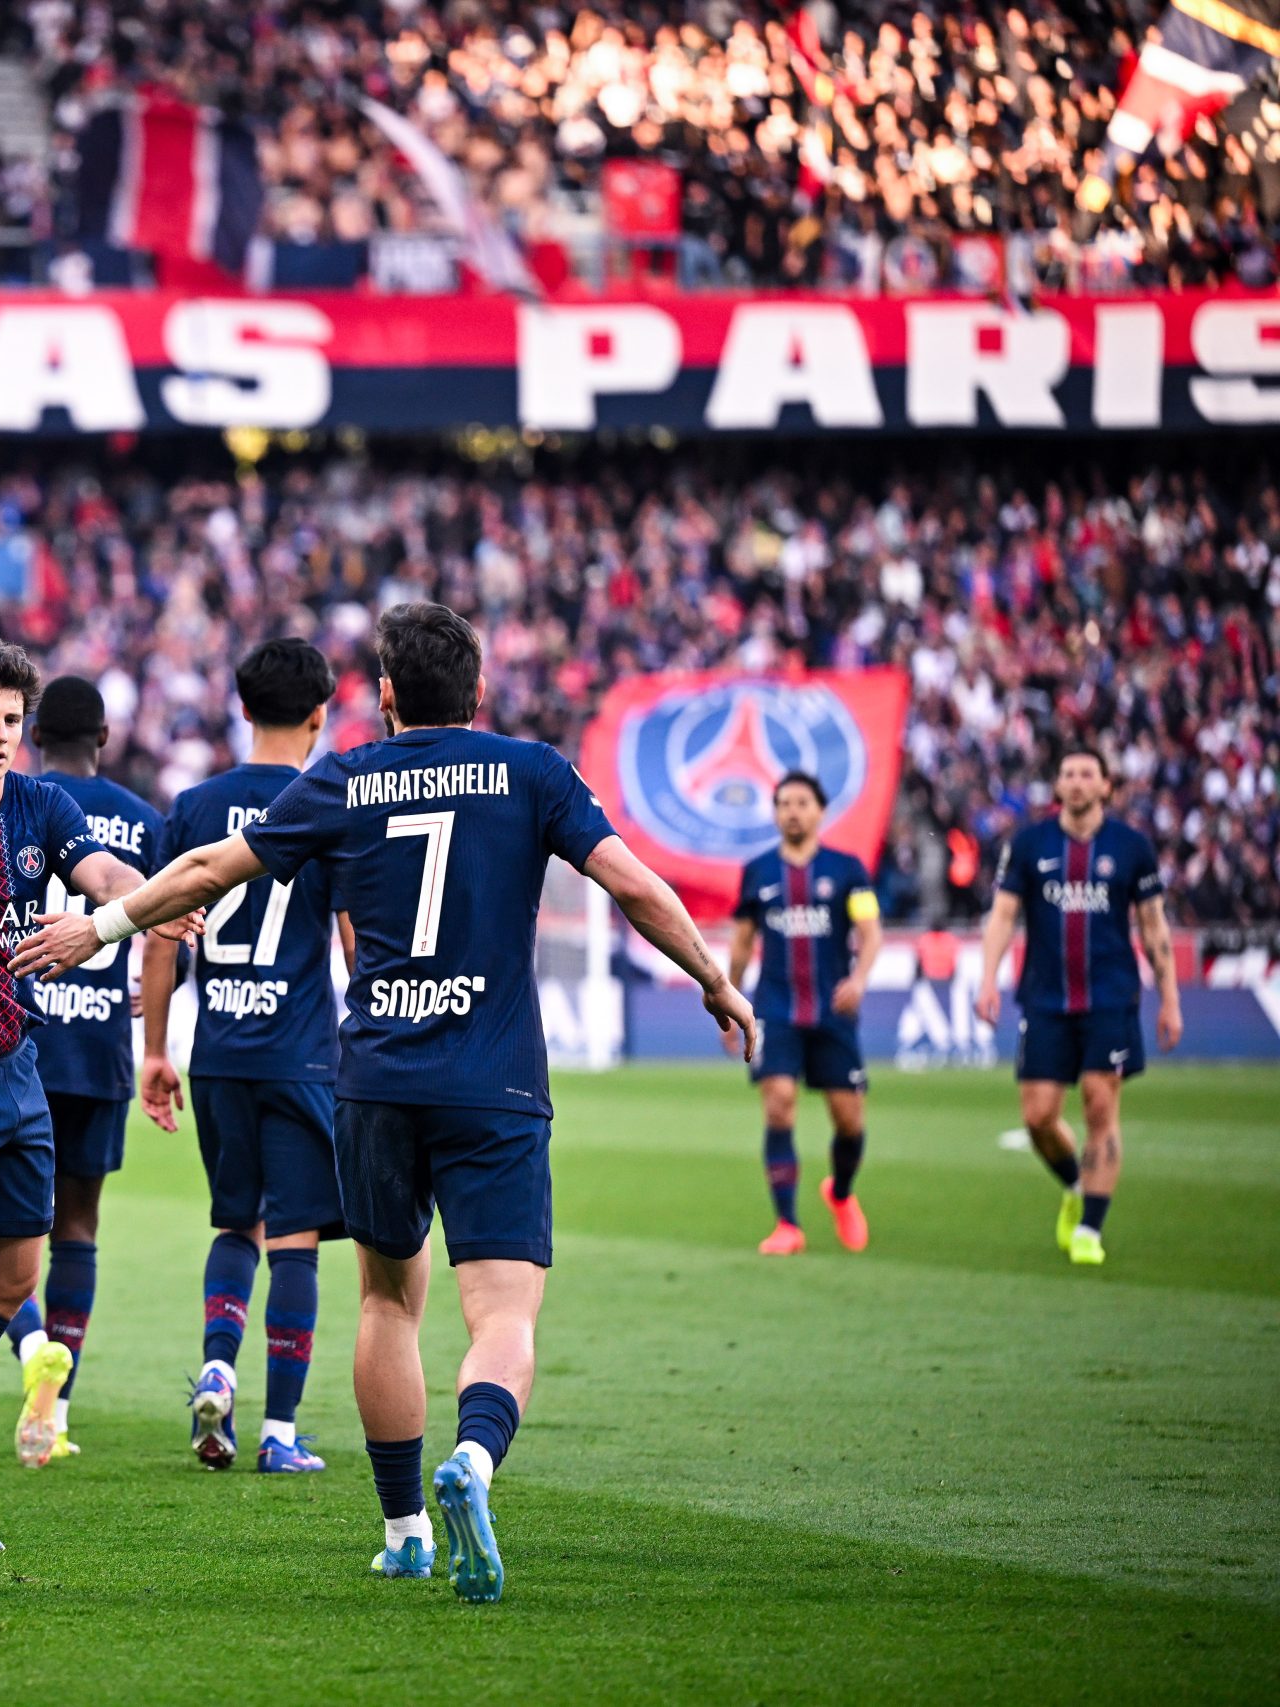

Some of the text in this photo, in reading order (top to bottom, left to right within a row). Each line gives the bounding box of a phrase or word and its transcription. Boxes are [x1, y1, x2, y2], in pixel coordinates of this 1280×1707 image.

[516, 300, 1280, 430] PARIS
[346, 762, 510, 809] KVARATSKHELIA
[227, 806, 269, 836] DR
[385, 810, 456, 958] 7
[203, 876, 297, 967] 27
[370, 976, 486, 1023] snipes
